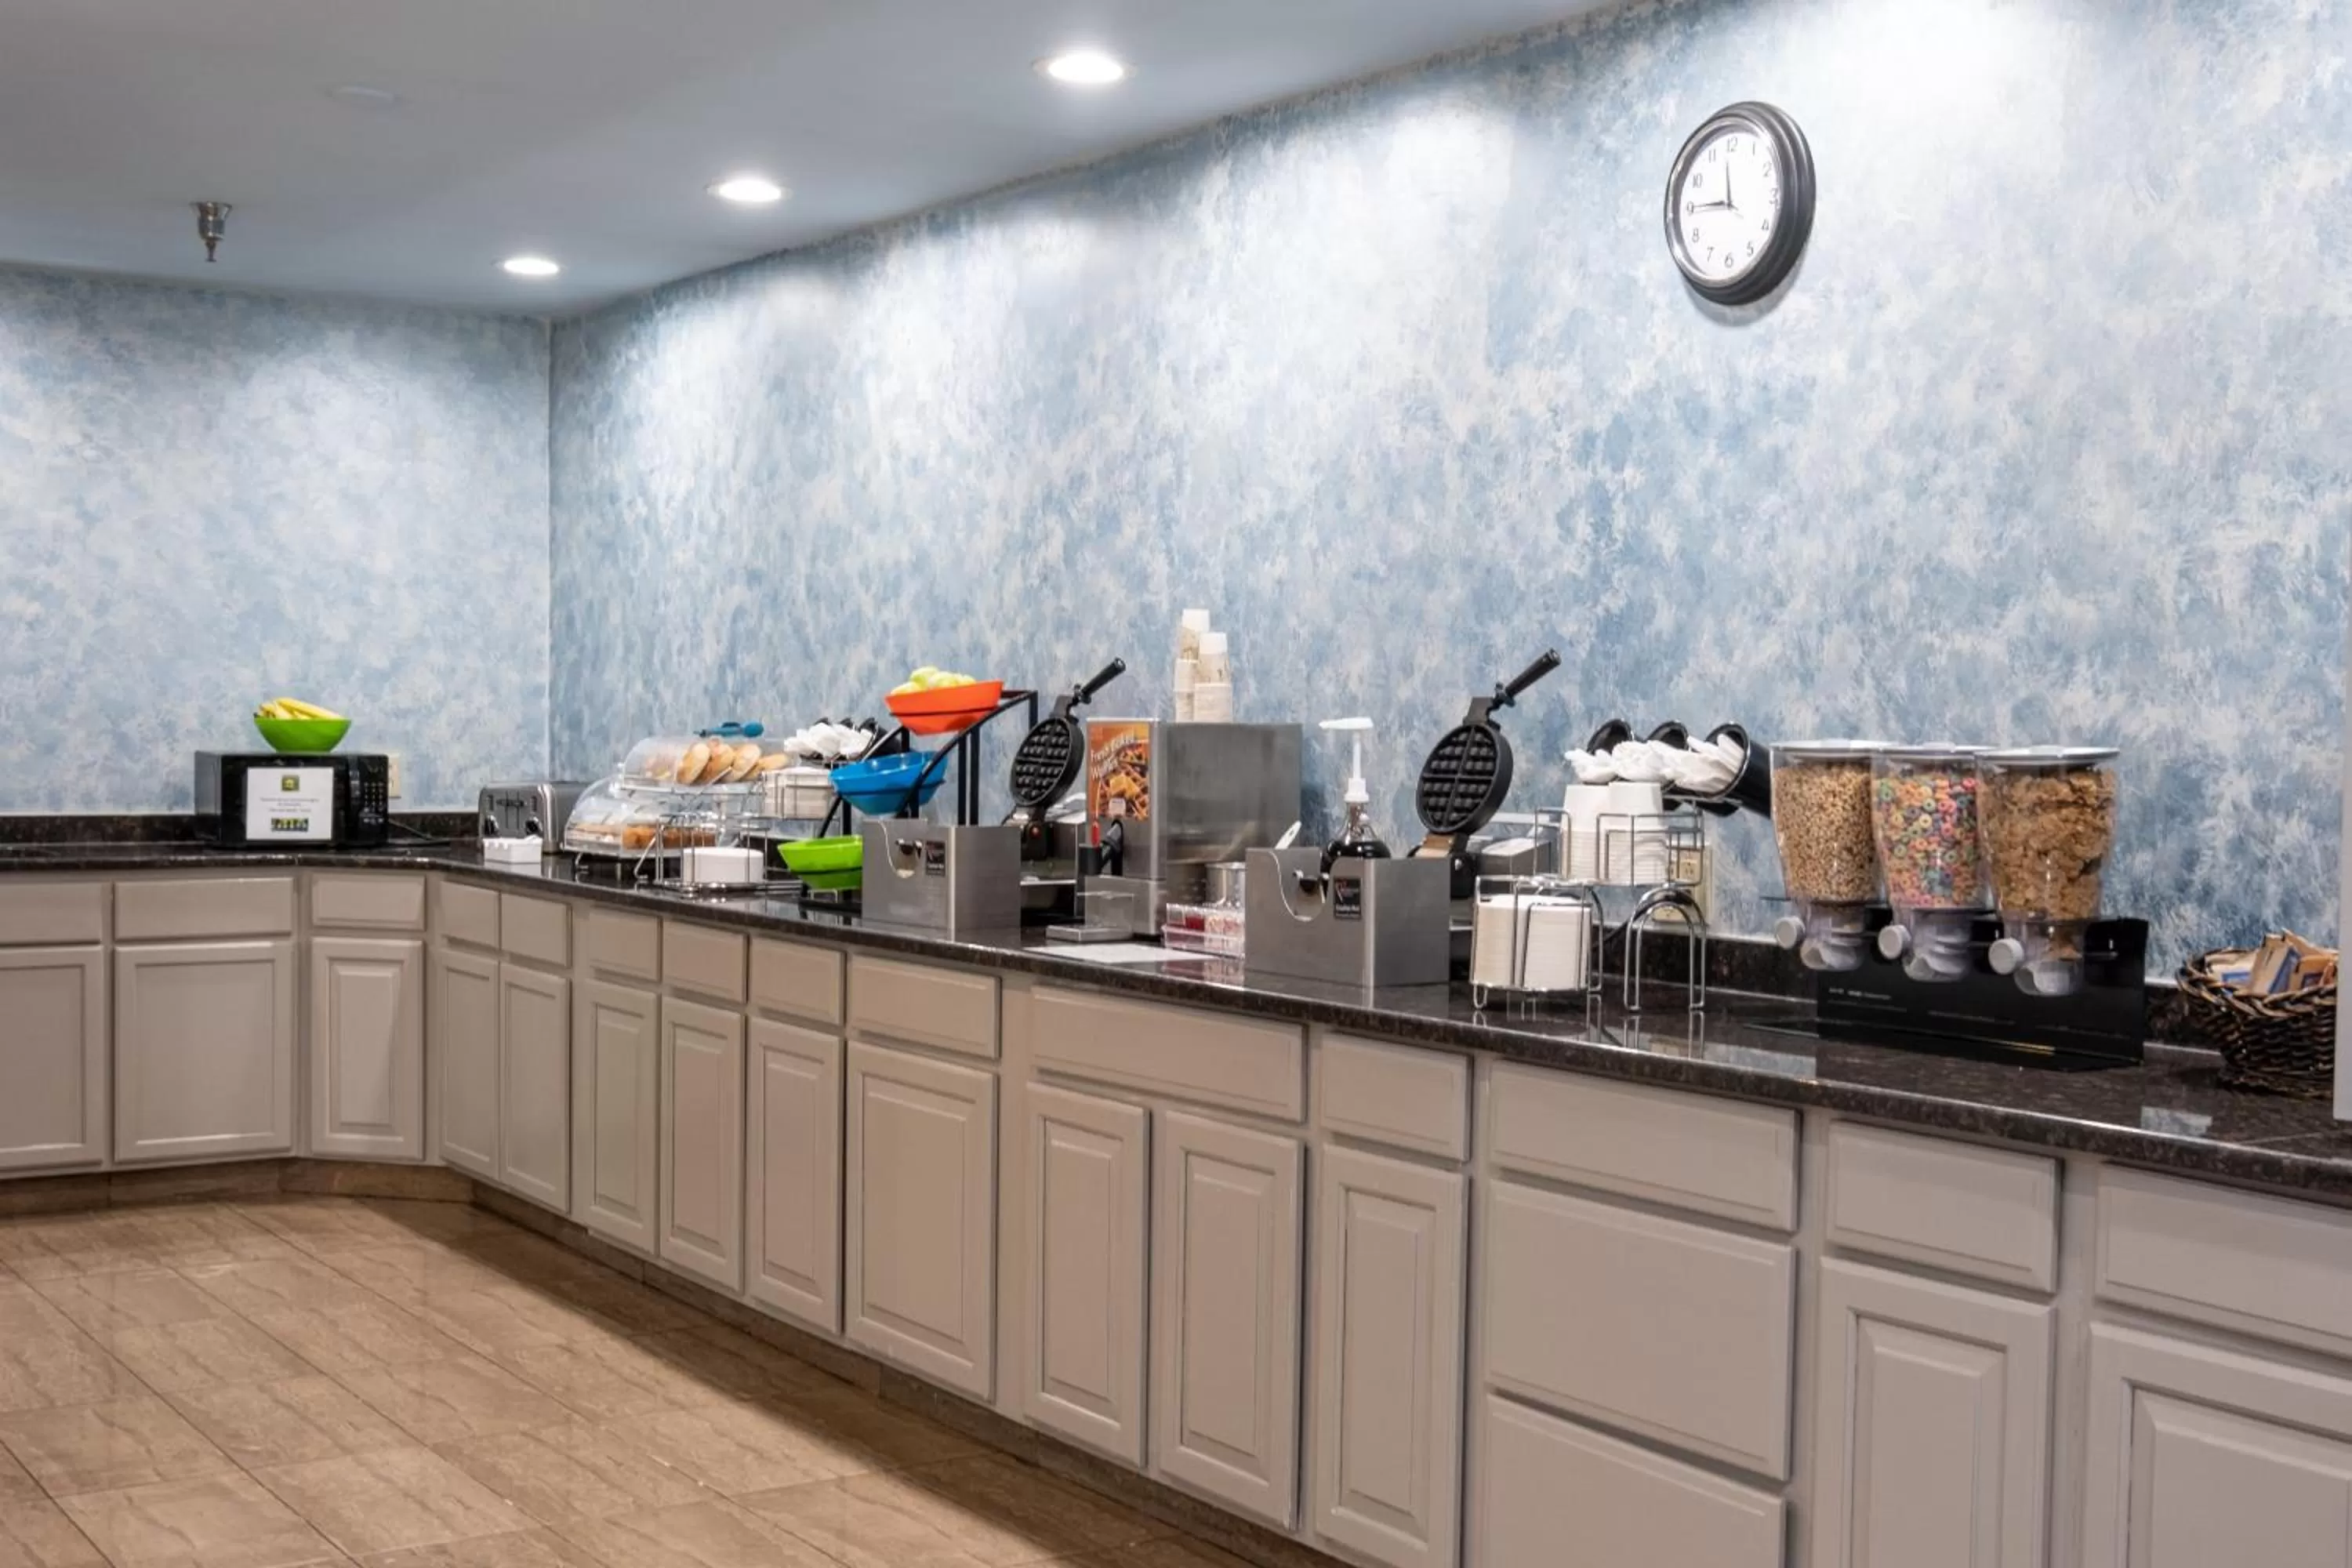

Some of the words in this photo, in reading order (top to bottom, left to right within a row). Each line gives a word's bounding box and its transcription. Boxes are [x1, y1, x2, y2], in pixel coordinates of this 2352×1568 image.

[1727, 136, 1738, 153] 12
[1708, 149, 1716, 163] 11
[1763, 161, 1772, 177] 2
[1692, 172, 1704, 188] 10
[1769, 187, 1779, 205] 3
[1686, 201, 1695, 216] 9
[1761, 219, 1769, 231] 4
[1692, 227, 1700, 243] 8
[1707, 246, 1715, 262] 7
[1747, 241, 1754, 257] 5
[1724, 252, 1734, 268] 6
